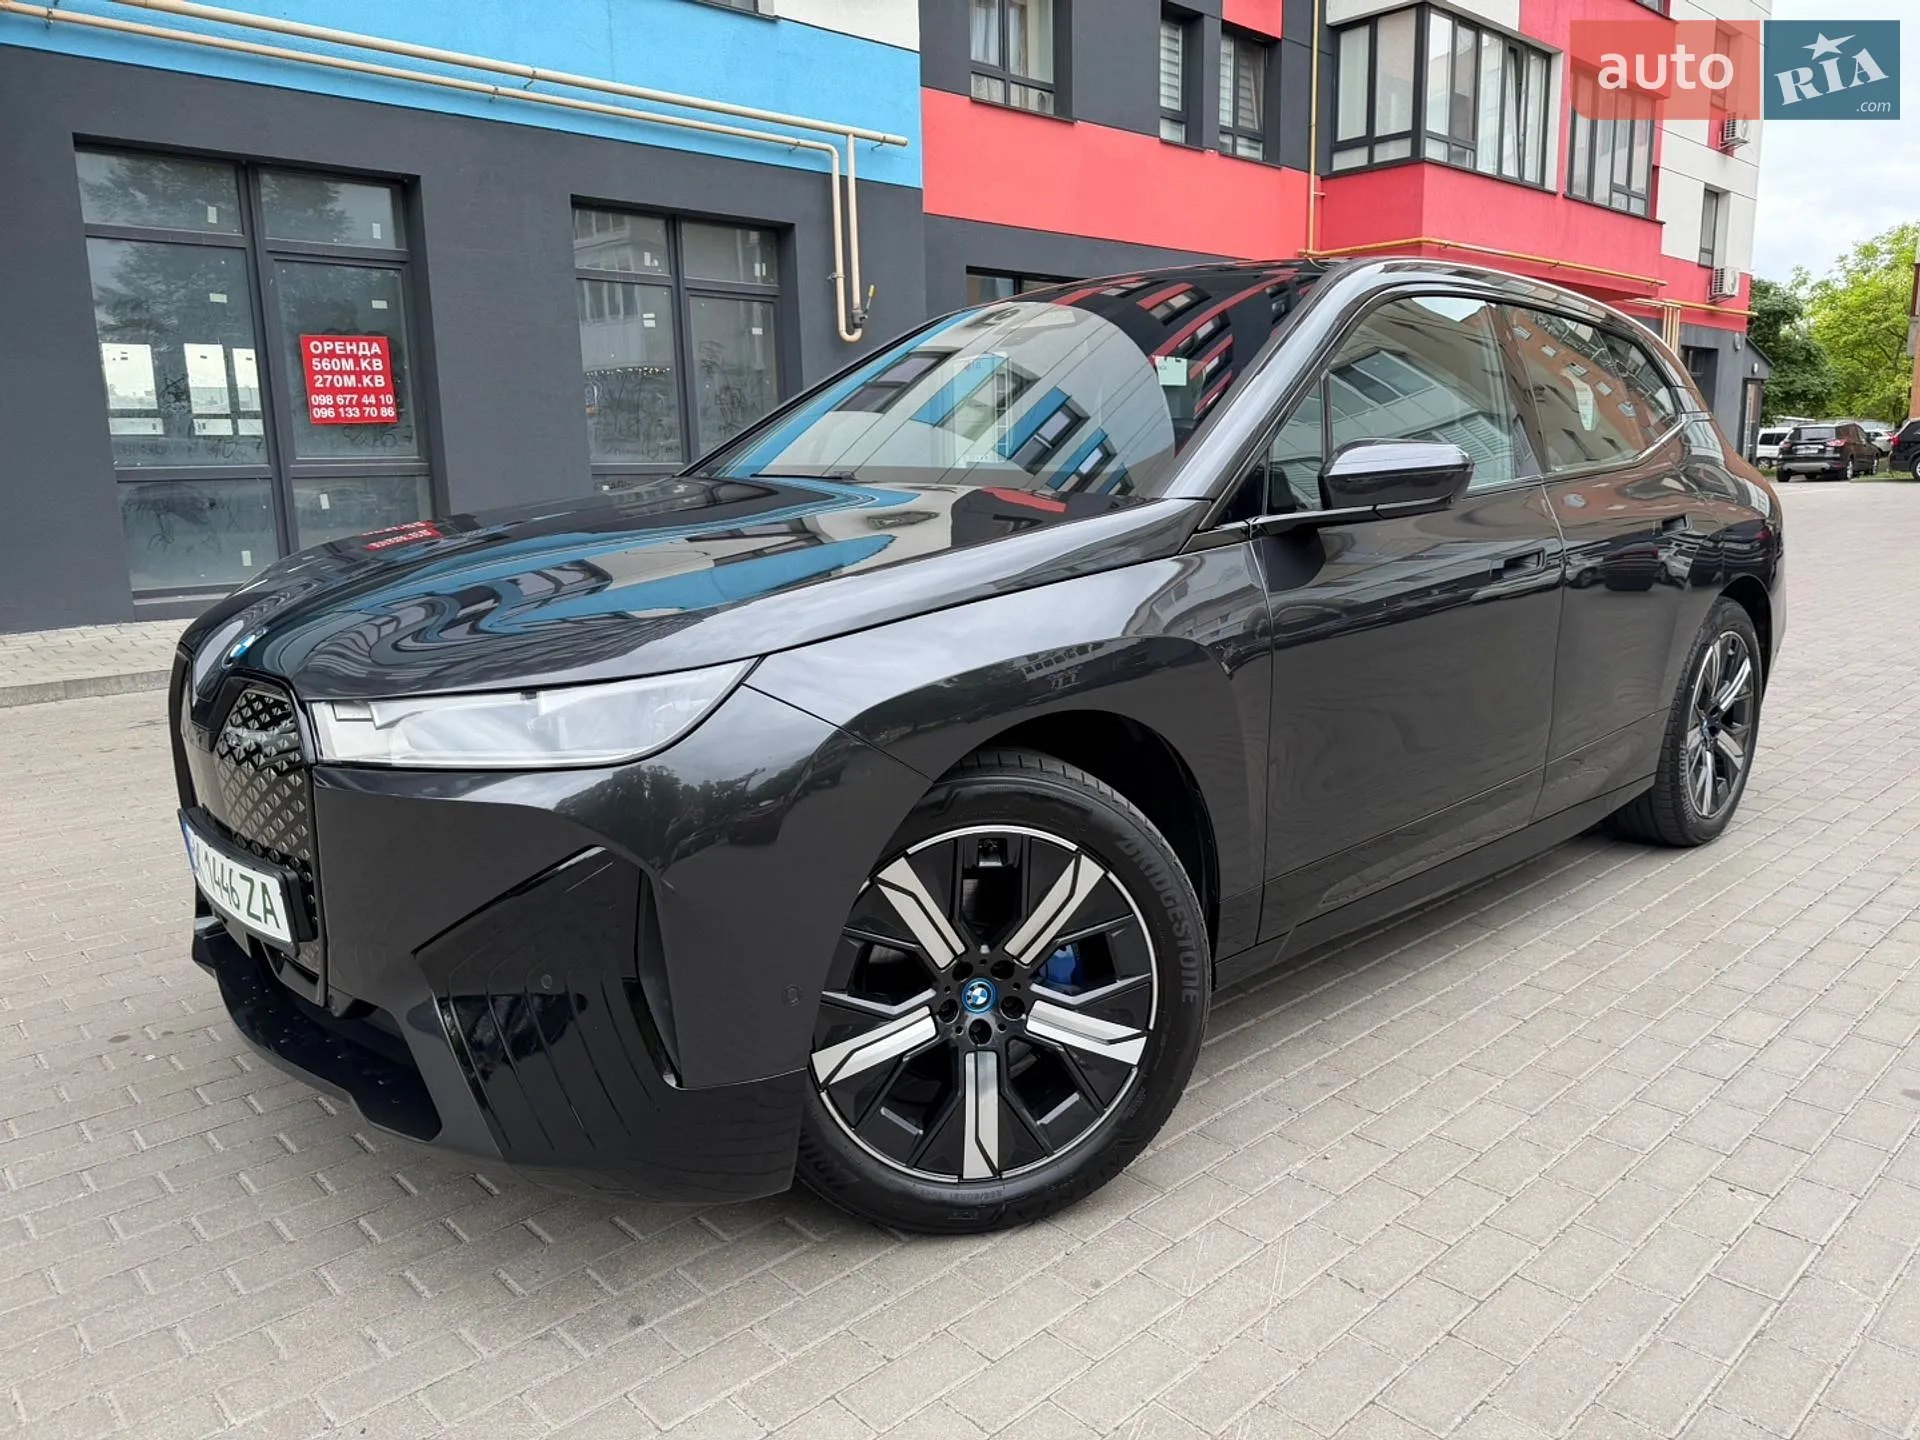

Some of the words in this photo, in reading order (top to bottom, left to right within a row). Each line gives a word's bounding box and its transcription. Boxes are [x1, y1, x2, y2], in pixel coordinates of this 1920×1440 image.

[309, 341, 382, 356] ОРЕНДА
[312, 358, 383, 371] 560М.КВ
[314, 375, 385, 388] 270М.КВ
[311, 395, 334, 405] 098
[336, 394, 358, 405] 677
[361, 394, 376, 405] 44
[379, 394, 393, 405] 10
[313, 407, 335, 418] 096
[338, 407, 360, 418] 133
[363, 407, 378, 417] 70
[380, 407, 395, 417] 86
[1115, 833, 1199, 1004] BRIDGESTONE
